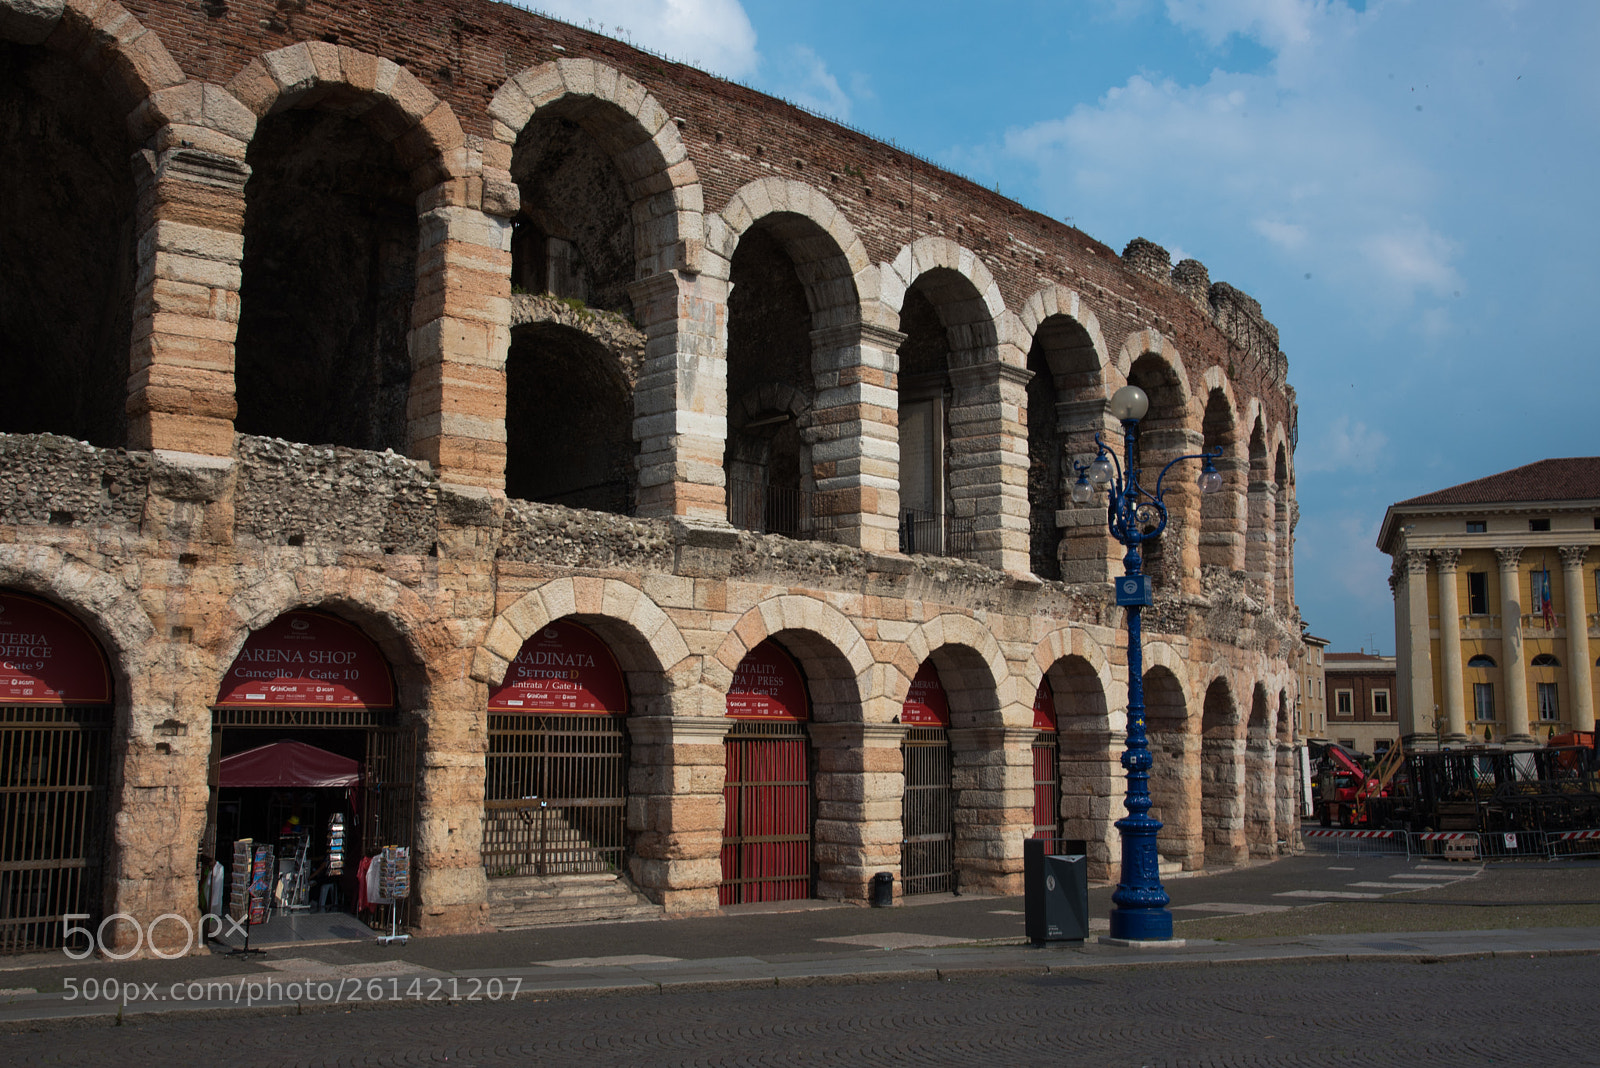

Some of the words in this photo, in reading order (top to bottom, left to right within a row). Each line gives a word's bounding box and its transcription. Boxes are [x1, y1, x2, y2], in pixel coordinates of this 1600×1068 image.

[239, 649, 304, 663] ARENA
[309, 650, 357, 664] SHOP
[3, 661, 33, 670] Gate
[36, 661, 44, 670] 9
[234, 667, 293, 678] Cancello
[309, 669, 340, 680] Gate
[344, 669, 359, 680] 10
[570, 669, 580, 680] D
[512, 680, 543, 690] Entrata
[552, 681, 572, 690] Gate
[574, 682, 583, 690] 11
[757, 675, 784, 686] PRESS
[752, 688, 769, 696] Gate
[770, 688, 778, 696] 12
